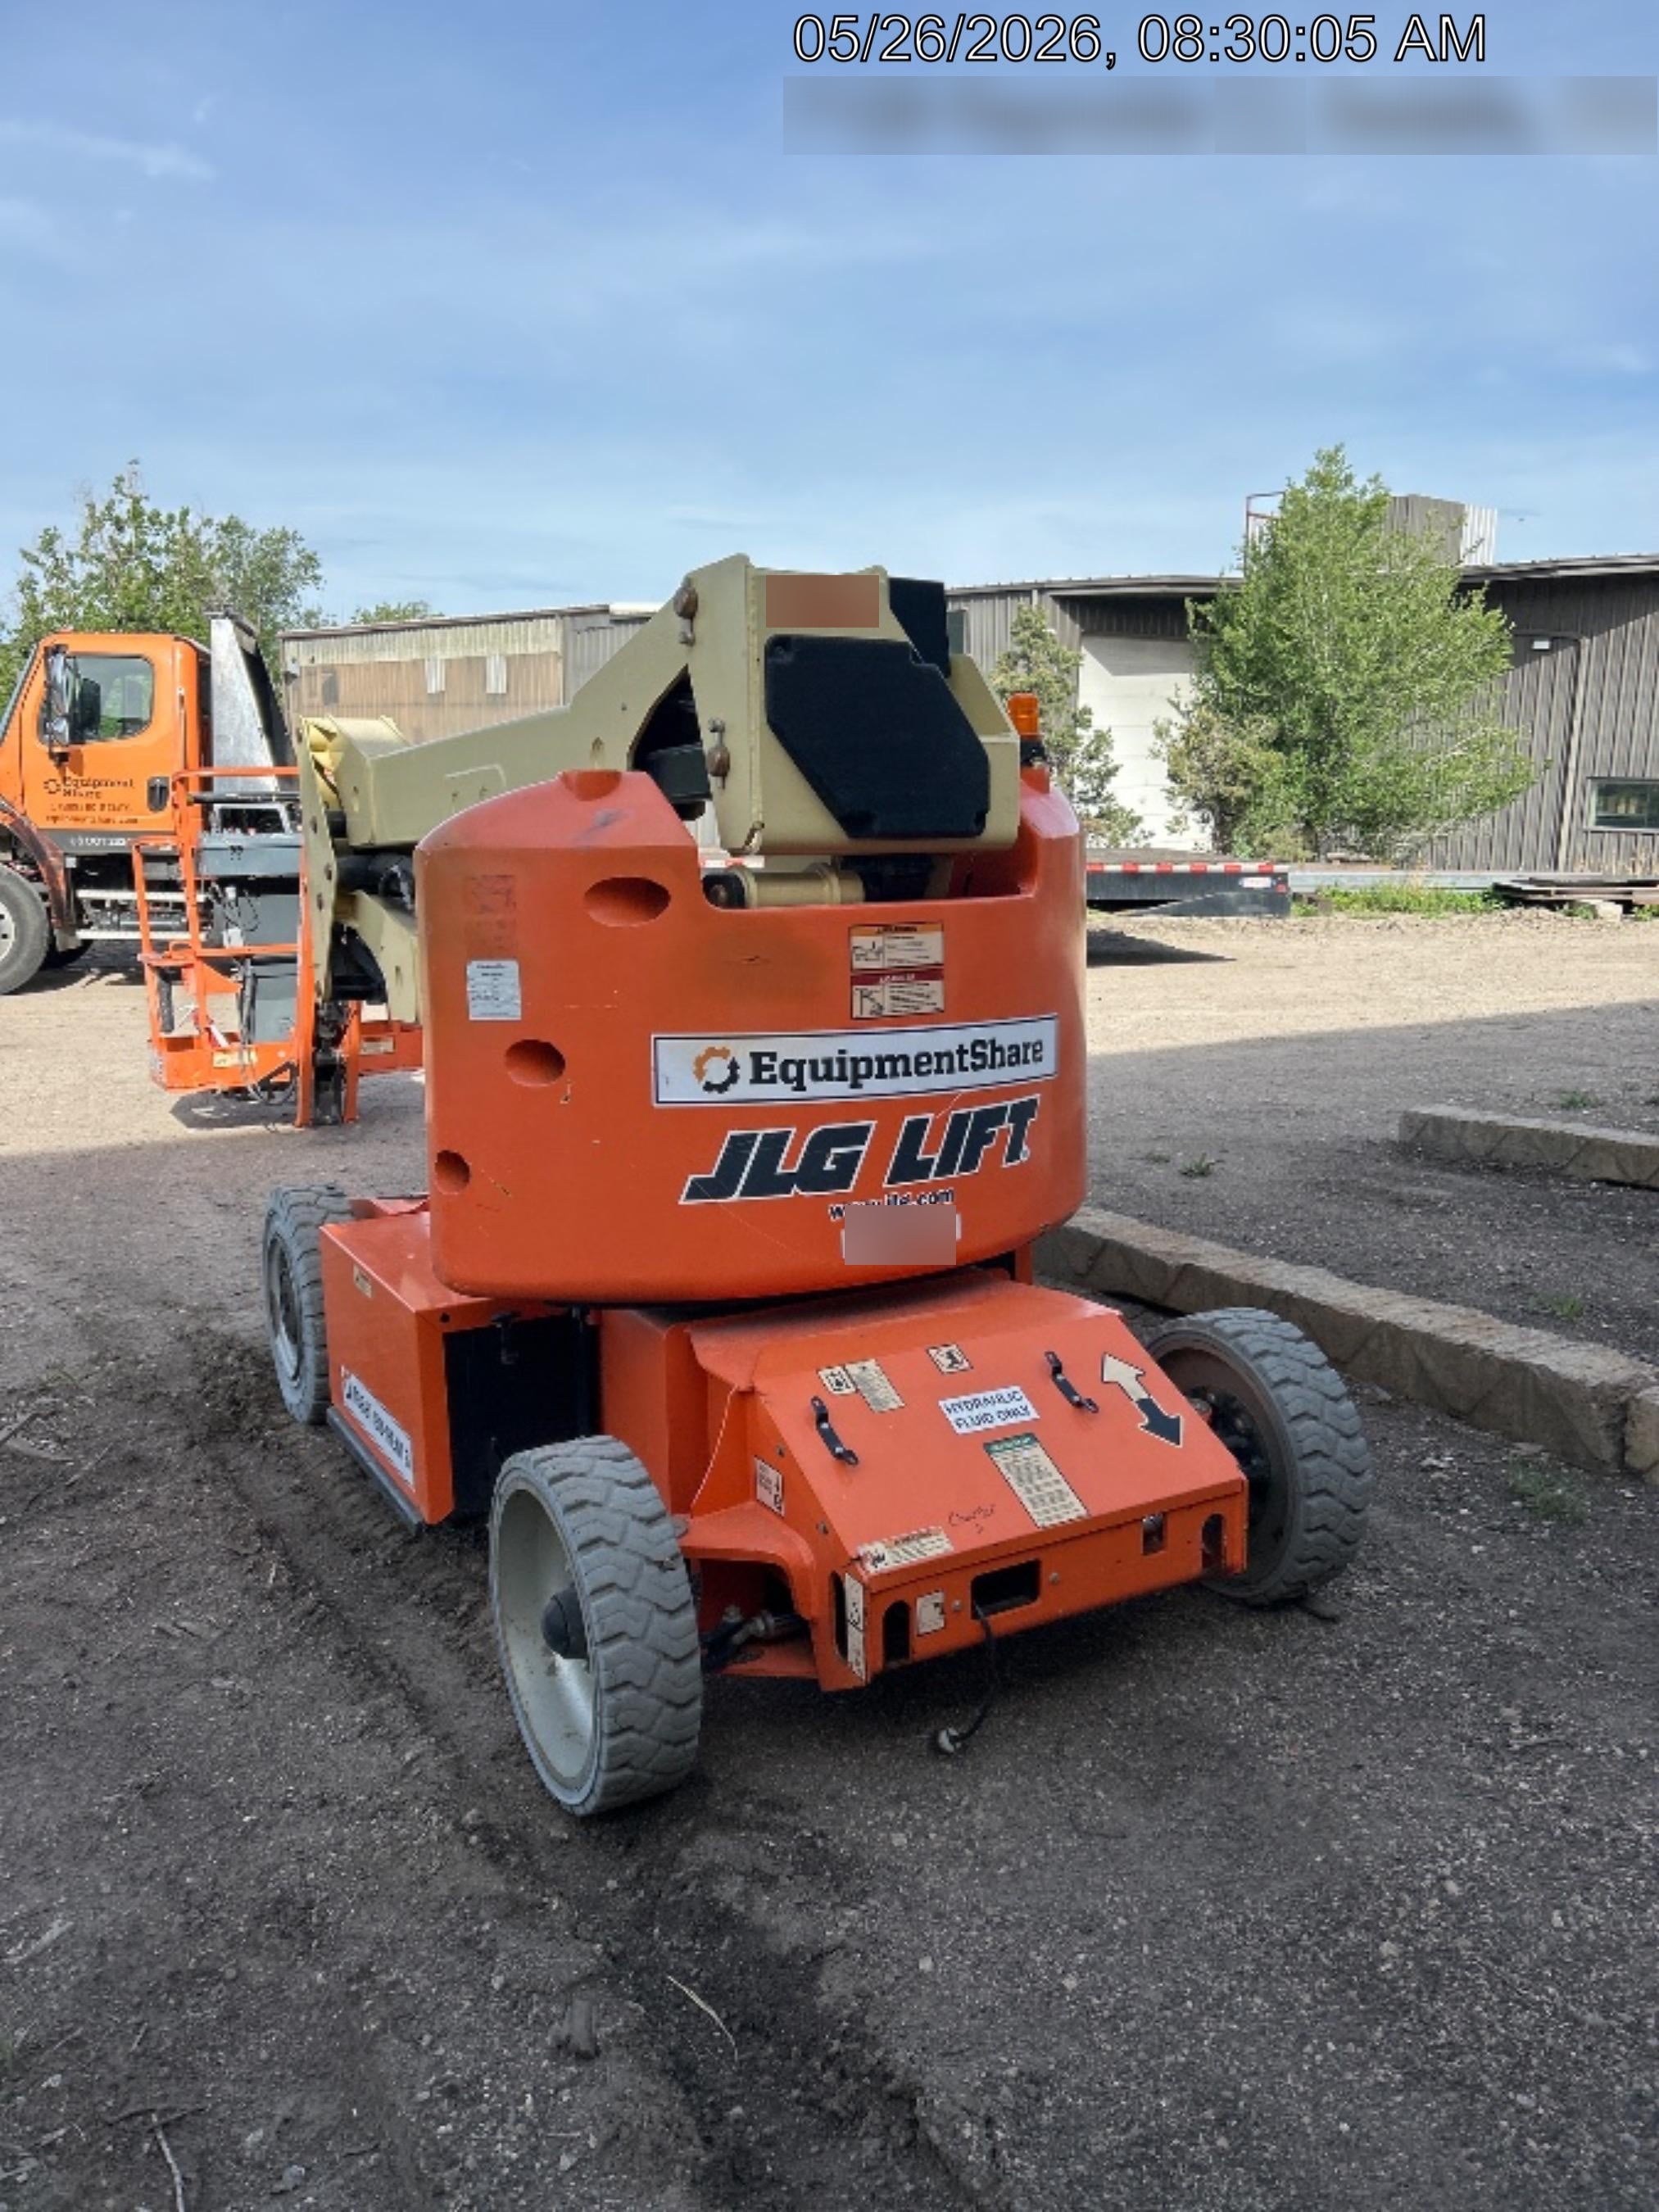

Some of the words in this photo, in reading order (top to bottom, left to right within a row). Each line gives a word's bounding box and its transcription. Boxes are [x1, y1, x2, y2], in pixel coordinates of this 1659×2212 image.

[749, 1037, 1044, 1092] EquipmentShare
[678, 1120, 877, 1205] JLG
[883, 1093, 1041, 1189] LIFT
[828, 1187, 954, 1222] wjlgcom
[943, 1390, 1023, 1414] HYDRAULIC
[954, 1412, 994, 1429] FLUID
[997, 1404, 1030, 1421] ONLY
